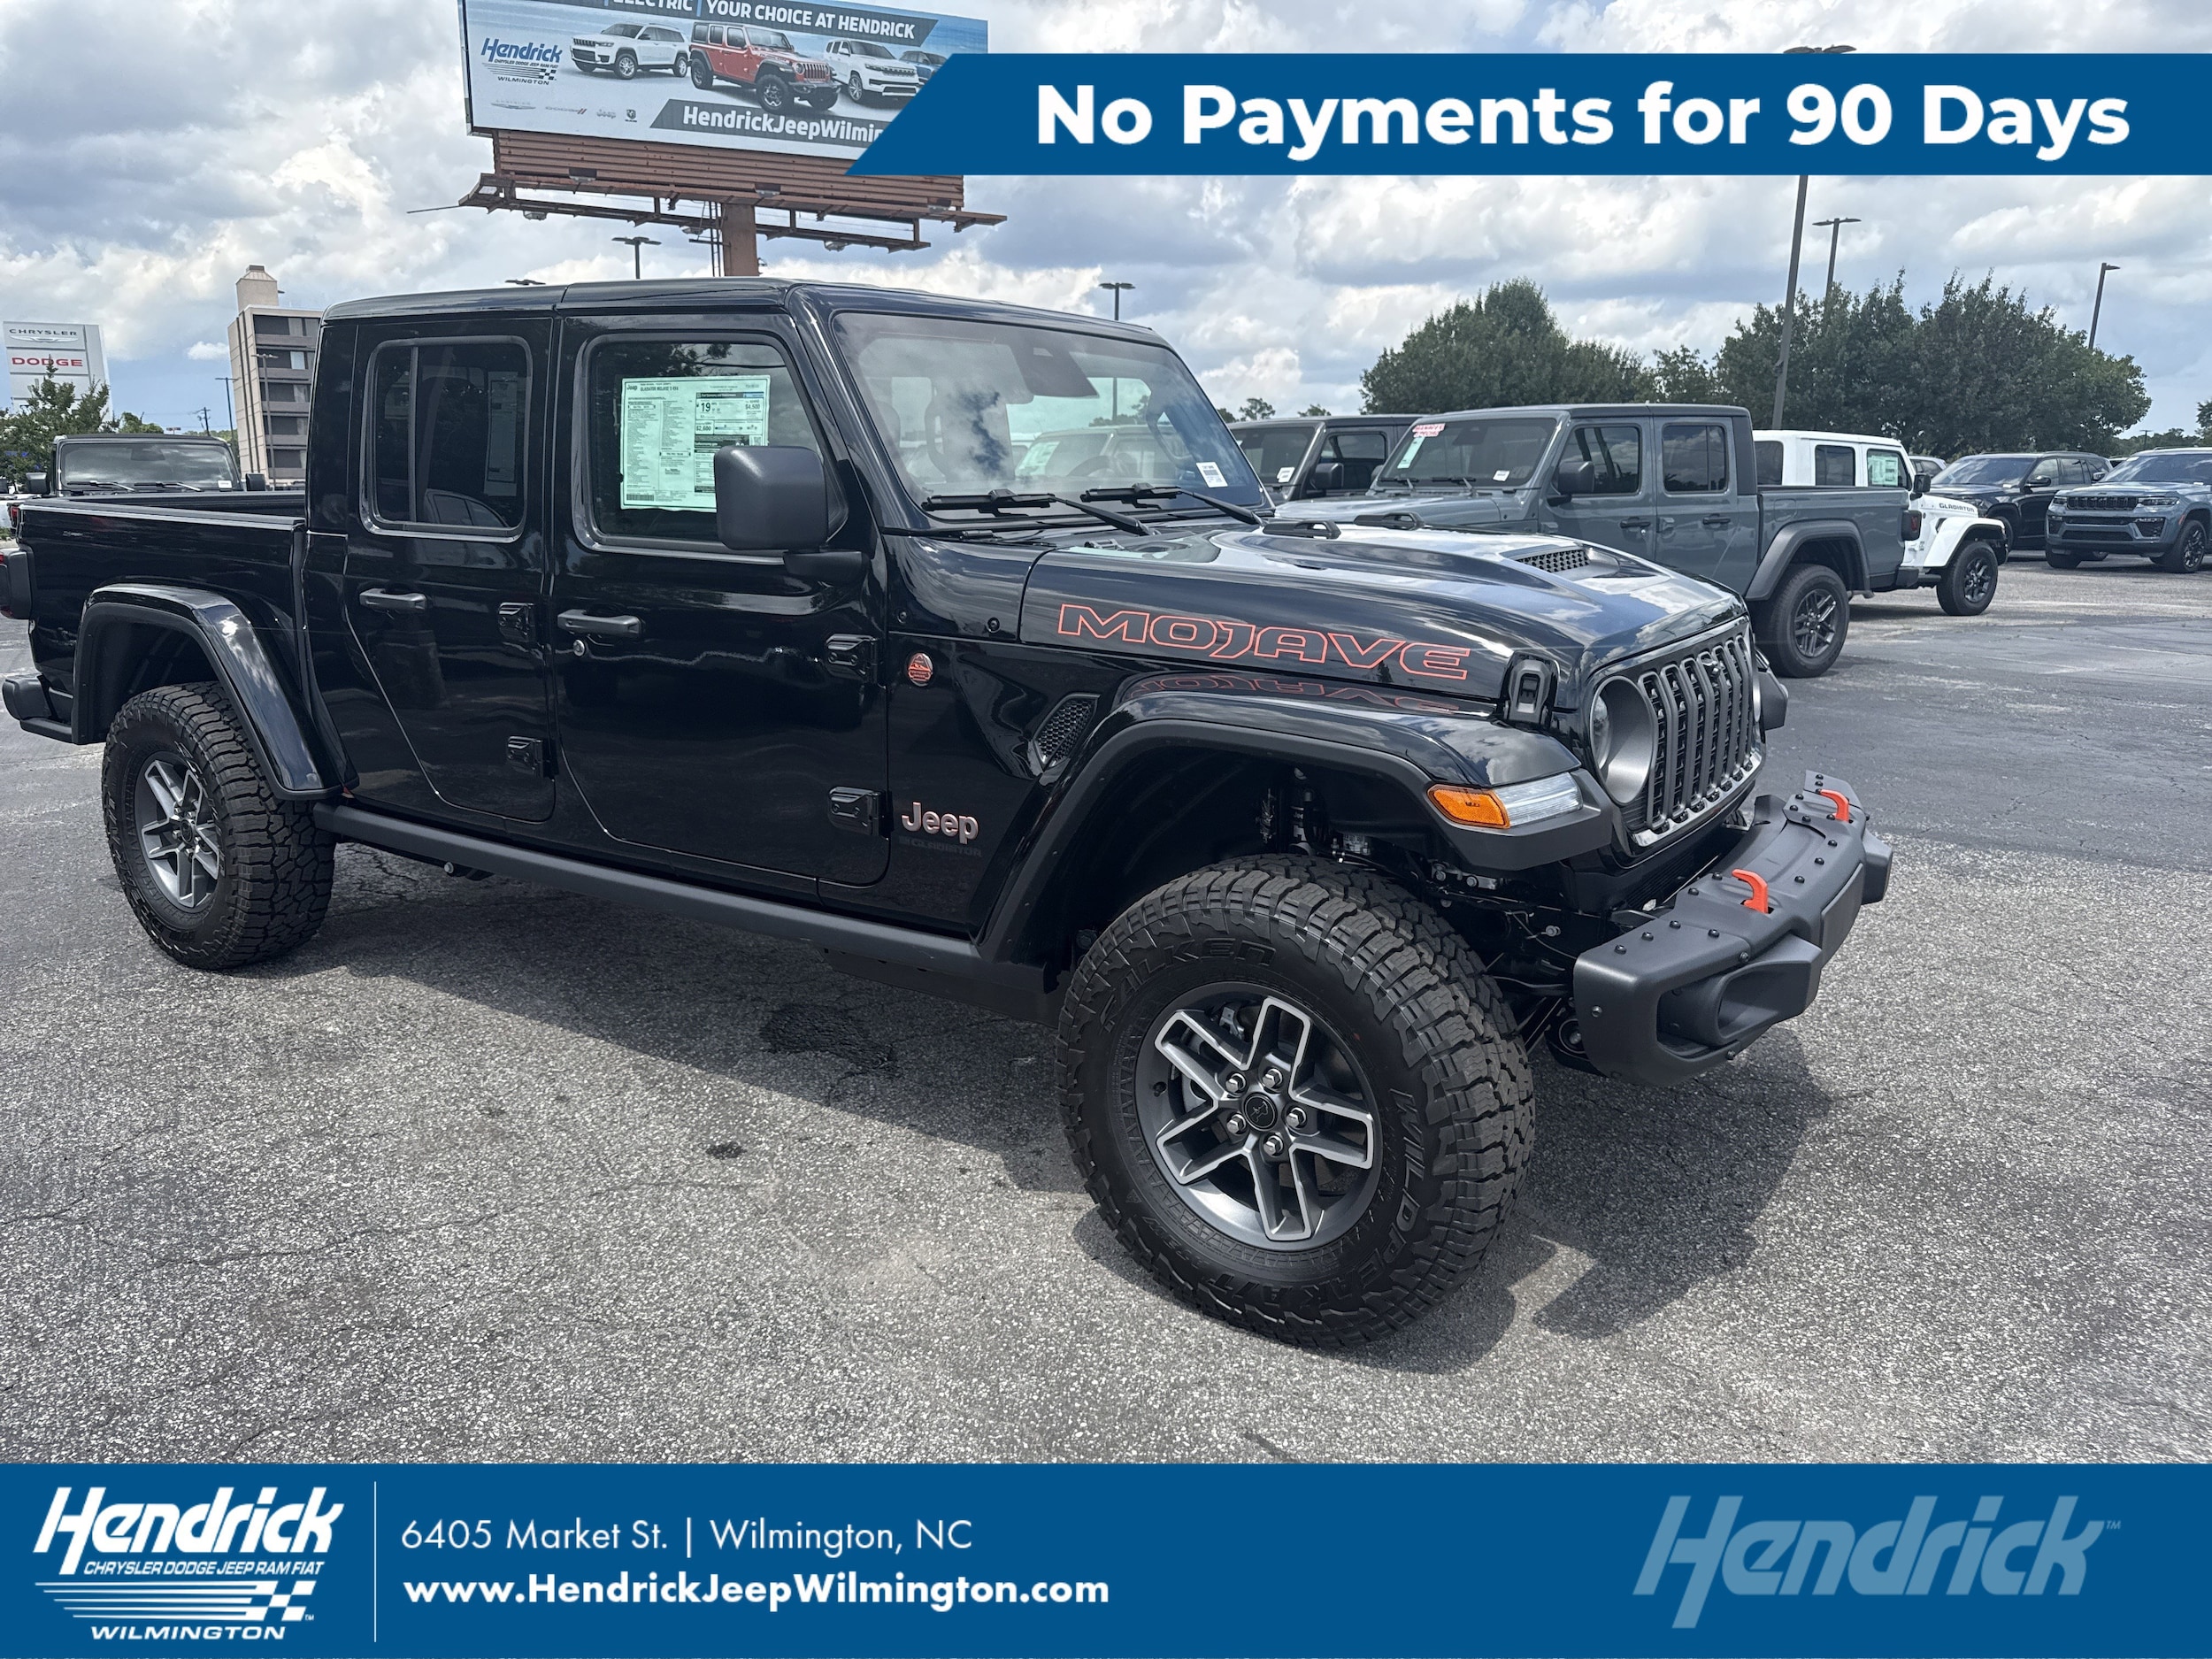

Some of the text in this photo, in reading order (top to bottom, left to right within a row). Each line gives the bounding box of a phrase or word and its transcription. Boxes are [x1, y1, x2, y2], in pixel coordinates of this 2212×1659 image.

[613, 0, 916, 39] CTRIC YOUR CHOICE AT HENDRICK
[480, 37, 563, 63] Hendrick
[497, 76, 549, 86] WILMINGTON
[12, 357, 83, 367] DODGE
[701, 402, 711, 412] 19
[1057, 603, 1471, 680] MOJAVE
[902, 802, 979, 845] Jeep
